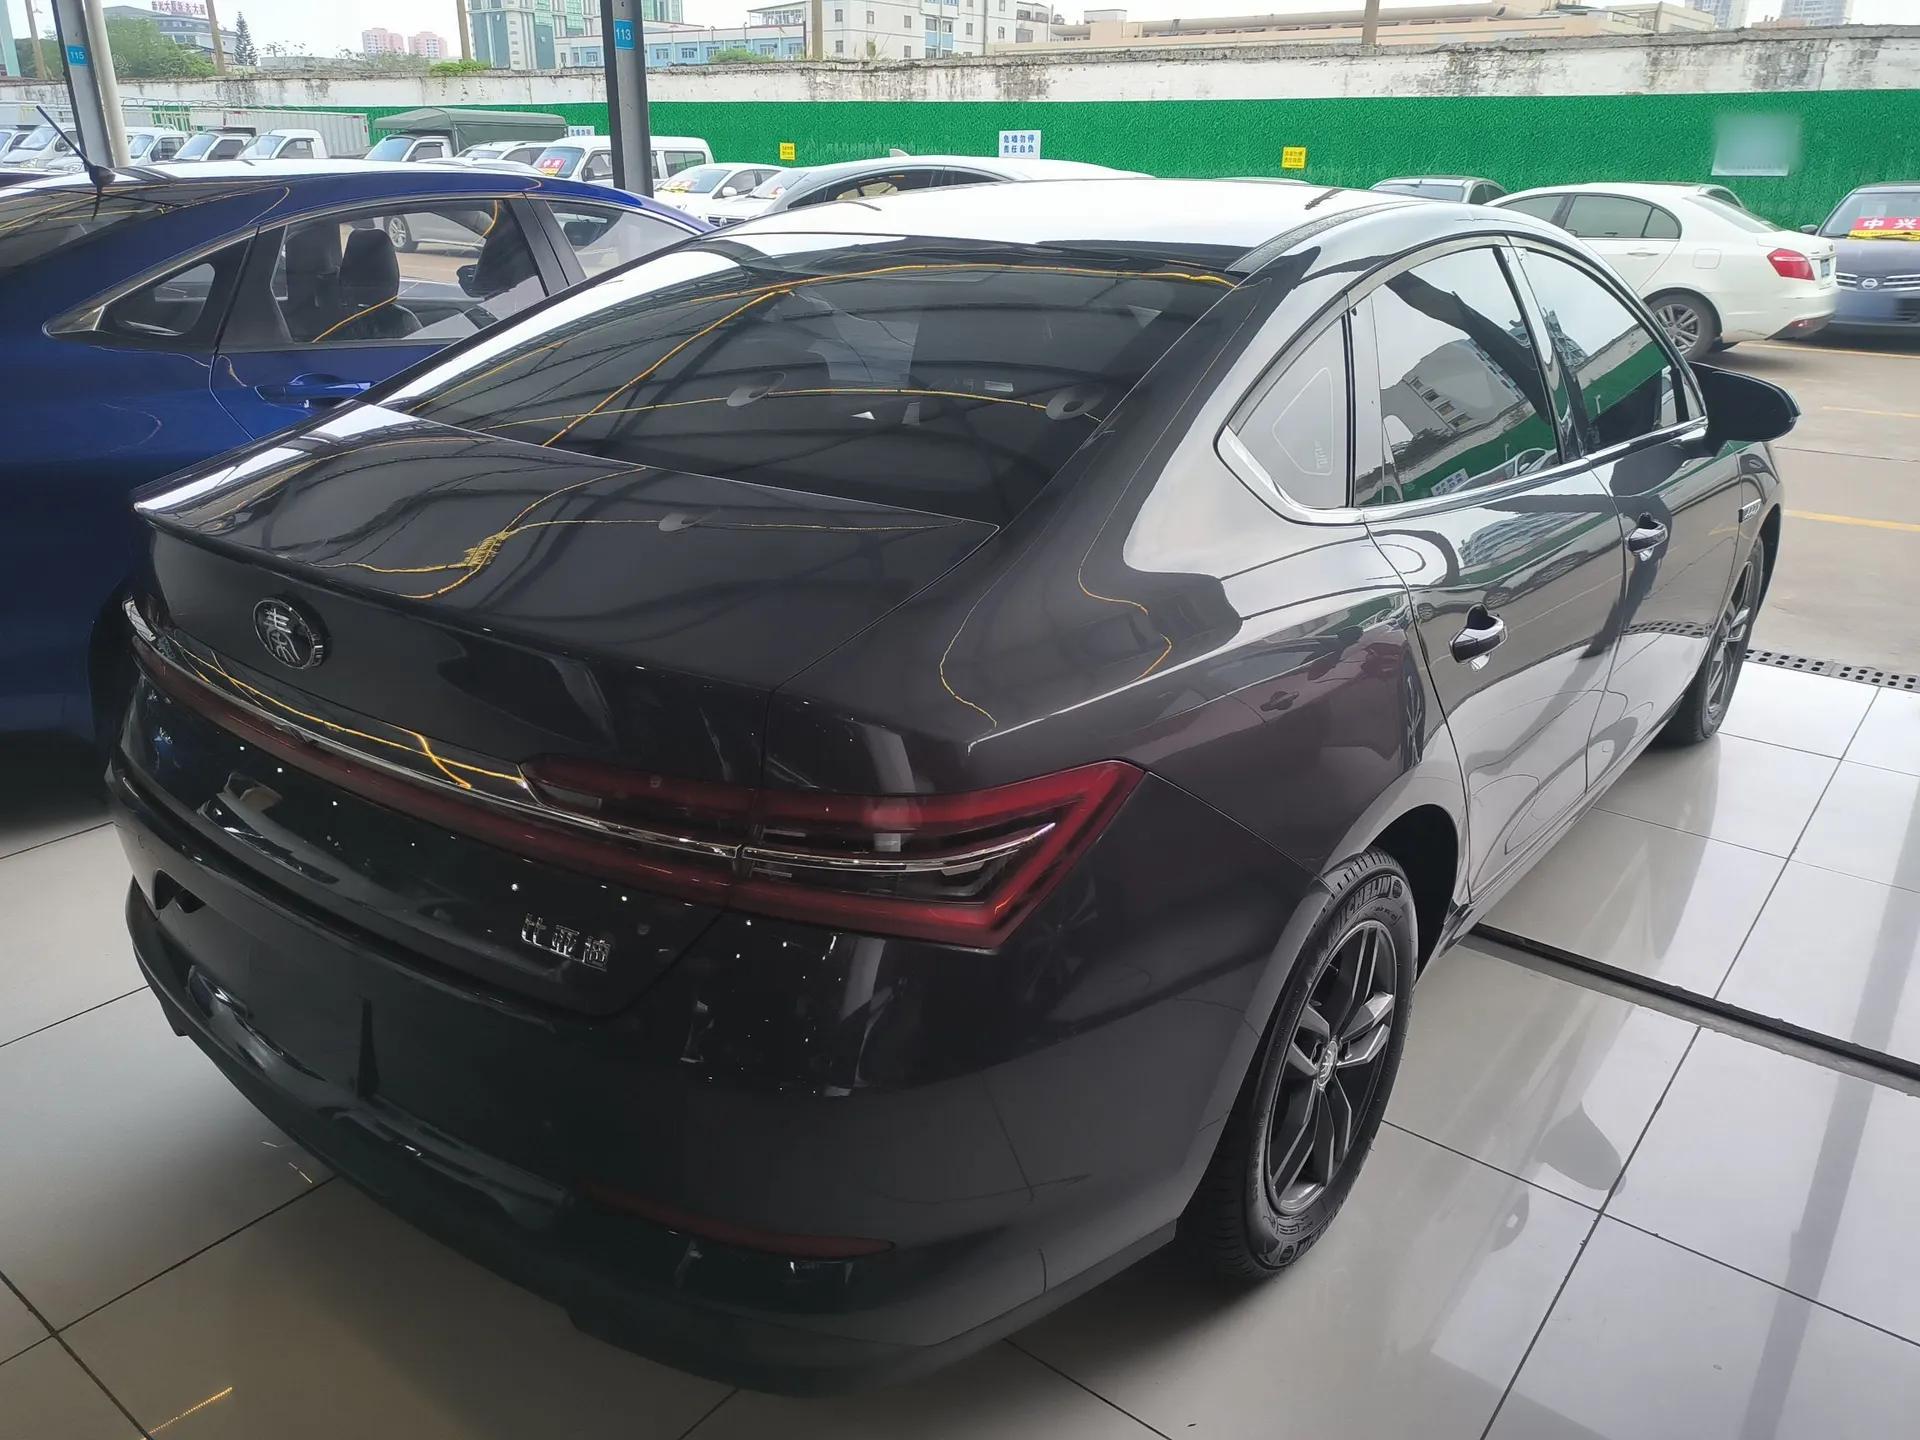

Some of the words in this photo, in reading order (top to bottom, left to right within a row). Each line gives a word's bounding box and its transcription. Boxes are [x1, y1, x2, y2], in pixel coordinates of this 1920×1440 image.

[616, 28, 631, 40] 113
[70, 51, 85, 60] 115
[1863, 217, 1918, 229] 中兴
[521, 913, 611, 971] 比亚迪
